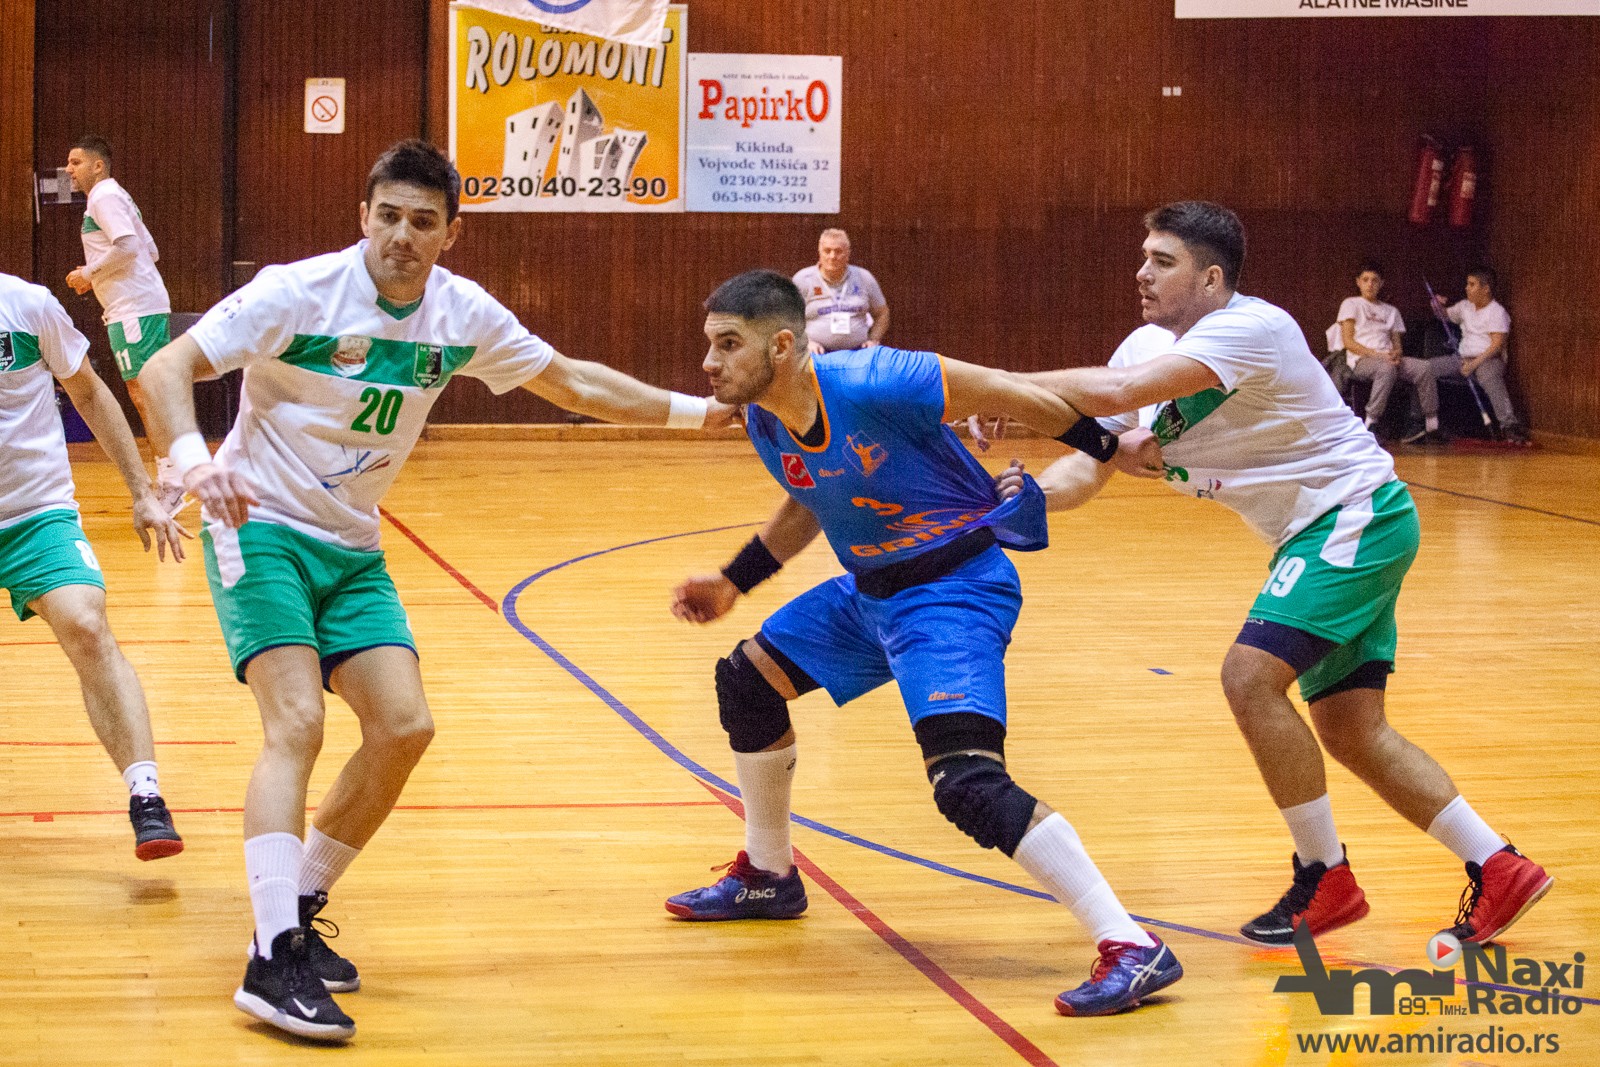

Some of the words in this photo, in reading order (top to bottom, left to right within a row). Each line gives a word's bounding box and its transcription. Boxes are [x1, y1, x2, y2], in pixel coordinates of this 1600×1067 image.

[465, 25, 674, 94] ROLOMONT
[698, 79, 829, 128] PapirkO
[735, 141, 794, 154] Kikinda
[698, 158, 756, 172] Vojvode
[812, 159, 830, 171] 32
[464, 176, 667, 198] 0230/40-23-90
[719, 174, 808, 187] 0230/29-322
[711, 191, 814, 204] 063-80-83-391
[115, 348, 132, 371] 11
[351, 386, 404, 435] 20
[851, 496, 904, 516] 3
[1260, 555, 1307, 598] 19
